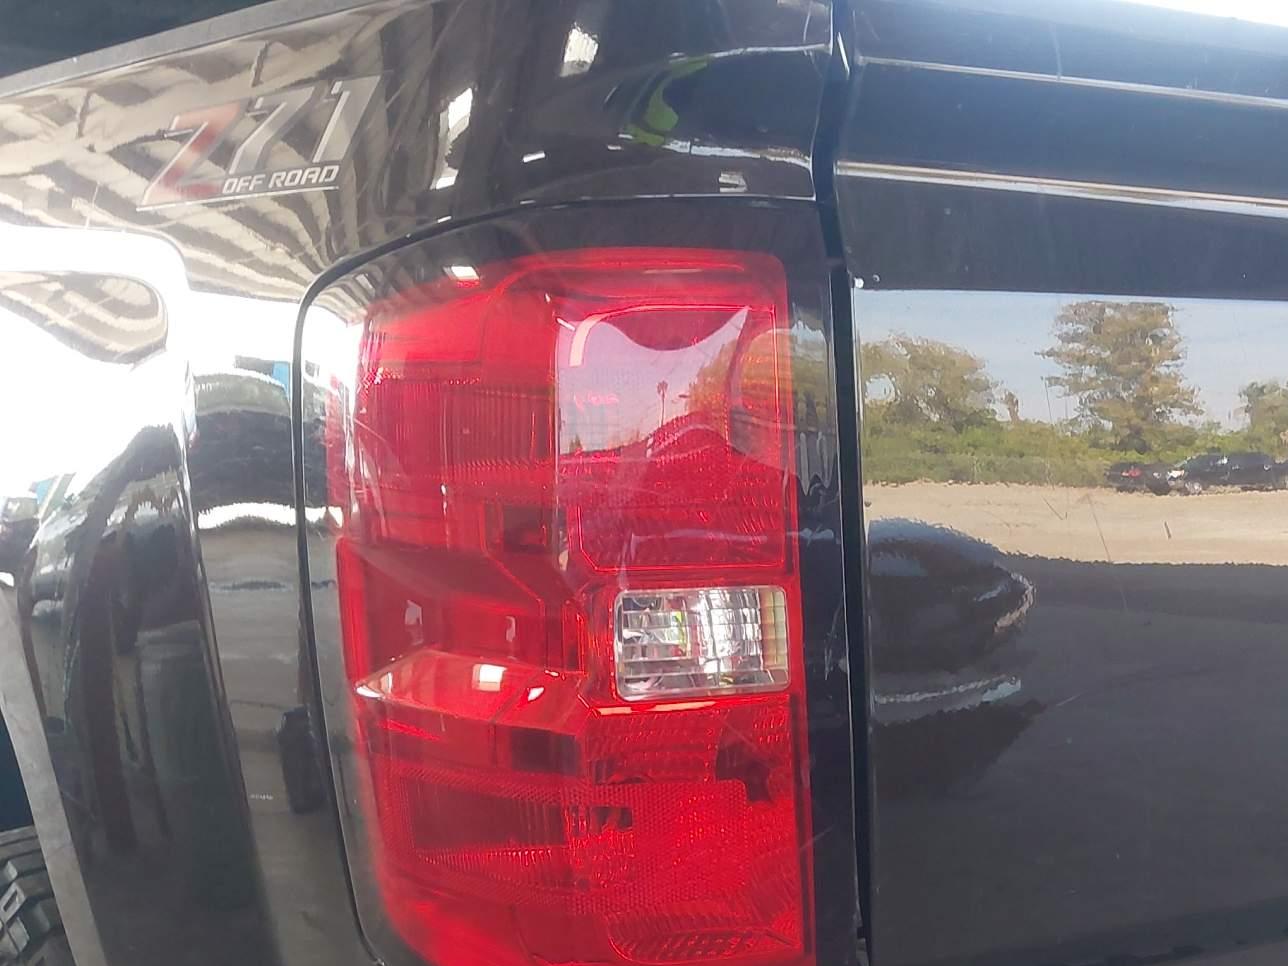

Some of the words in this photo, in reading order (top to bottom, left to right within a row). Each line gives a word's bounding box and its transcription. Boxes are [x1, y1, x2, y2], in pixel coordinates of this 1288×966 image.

[139, 75, 382, 205] Z71
[222, 174, 266, 194] OFF
[268, 164, 340, 189] ROAD
